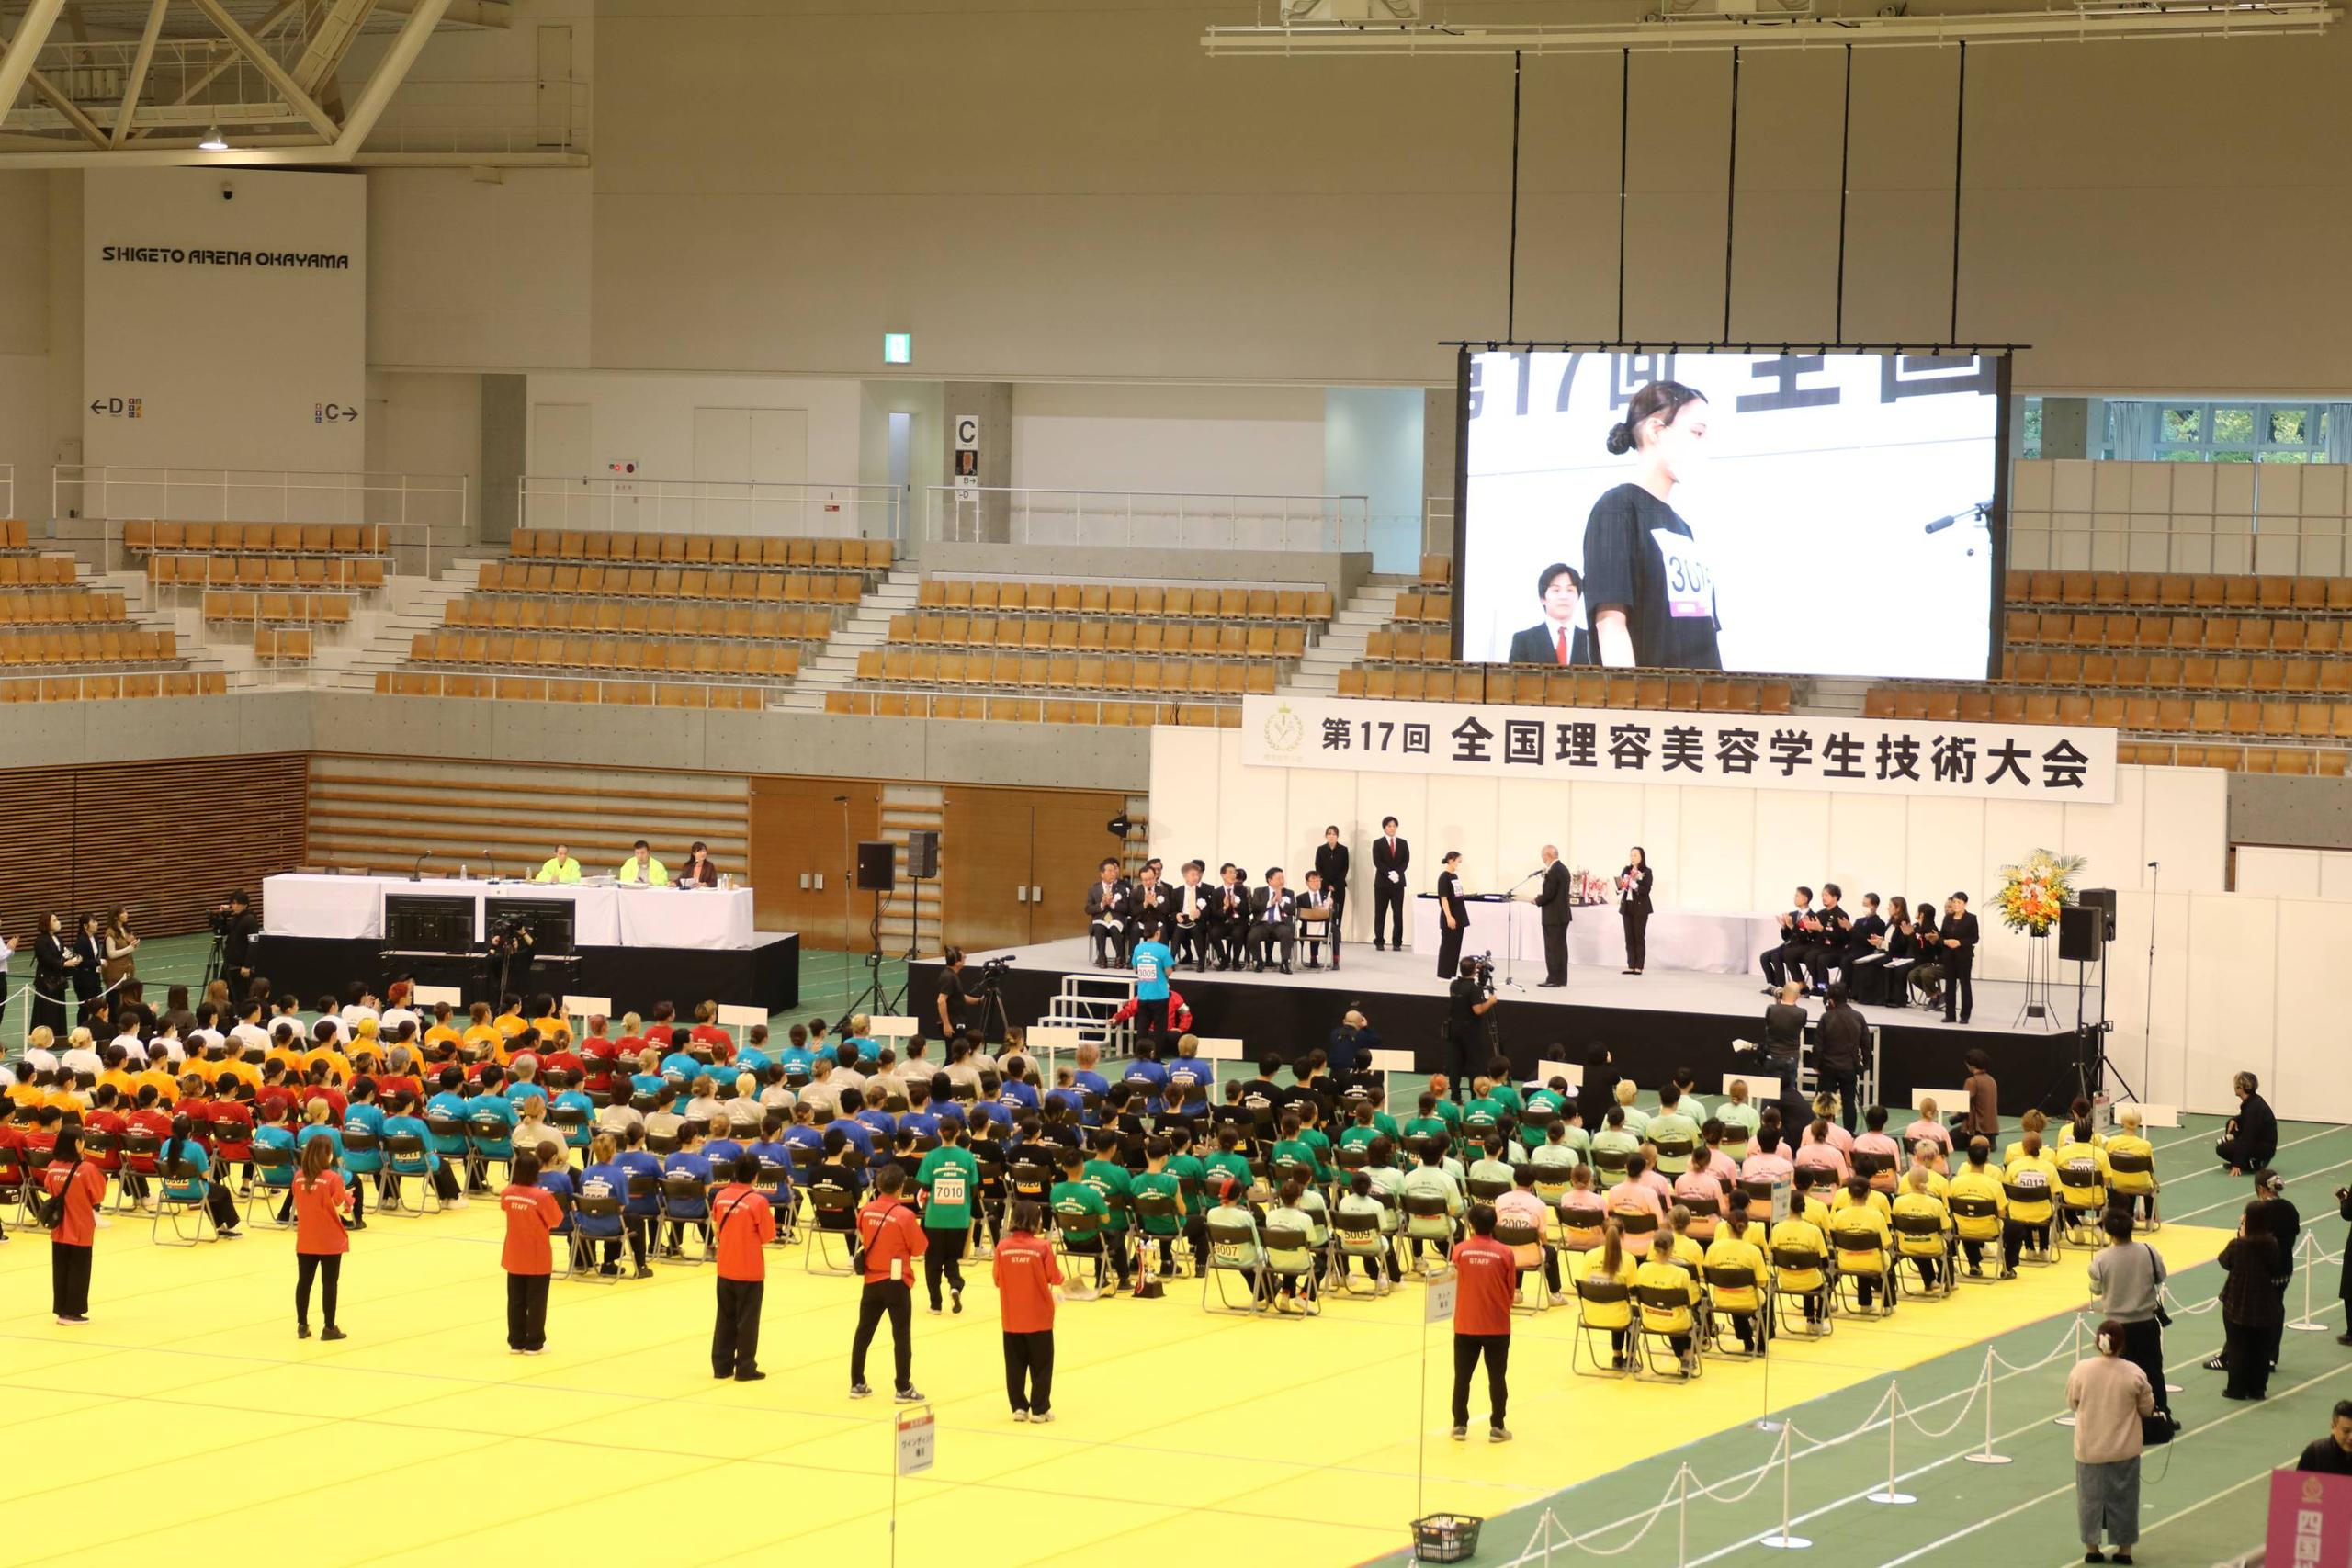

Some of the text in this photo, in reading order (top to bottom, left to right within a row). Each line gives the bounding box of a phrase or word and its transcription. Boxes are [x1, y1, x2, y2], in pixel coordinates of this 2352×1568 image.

[102, 246, 349, 269] SHIGETO ARENA OKAYAMA
[109, 398, 123, 413] D
[325, 404, 339, 420] C
[959, 420, 976, 443] C
[1321, 716, 2090, 790] 第17回 全国理容美容学生技術大会
[1138, 969, 1156, 977] 3005
[937, 1187, 963, 1198] 7010
[511, 1202, 528, 1211] STAFF
[1345, 1230, 1370, 1239] 5009
